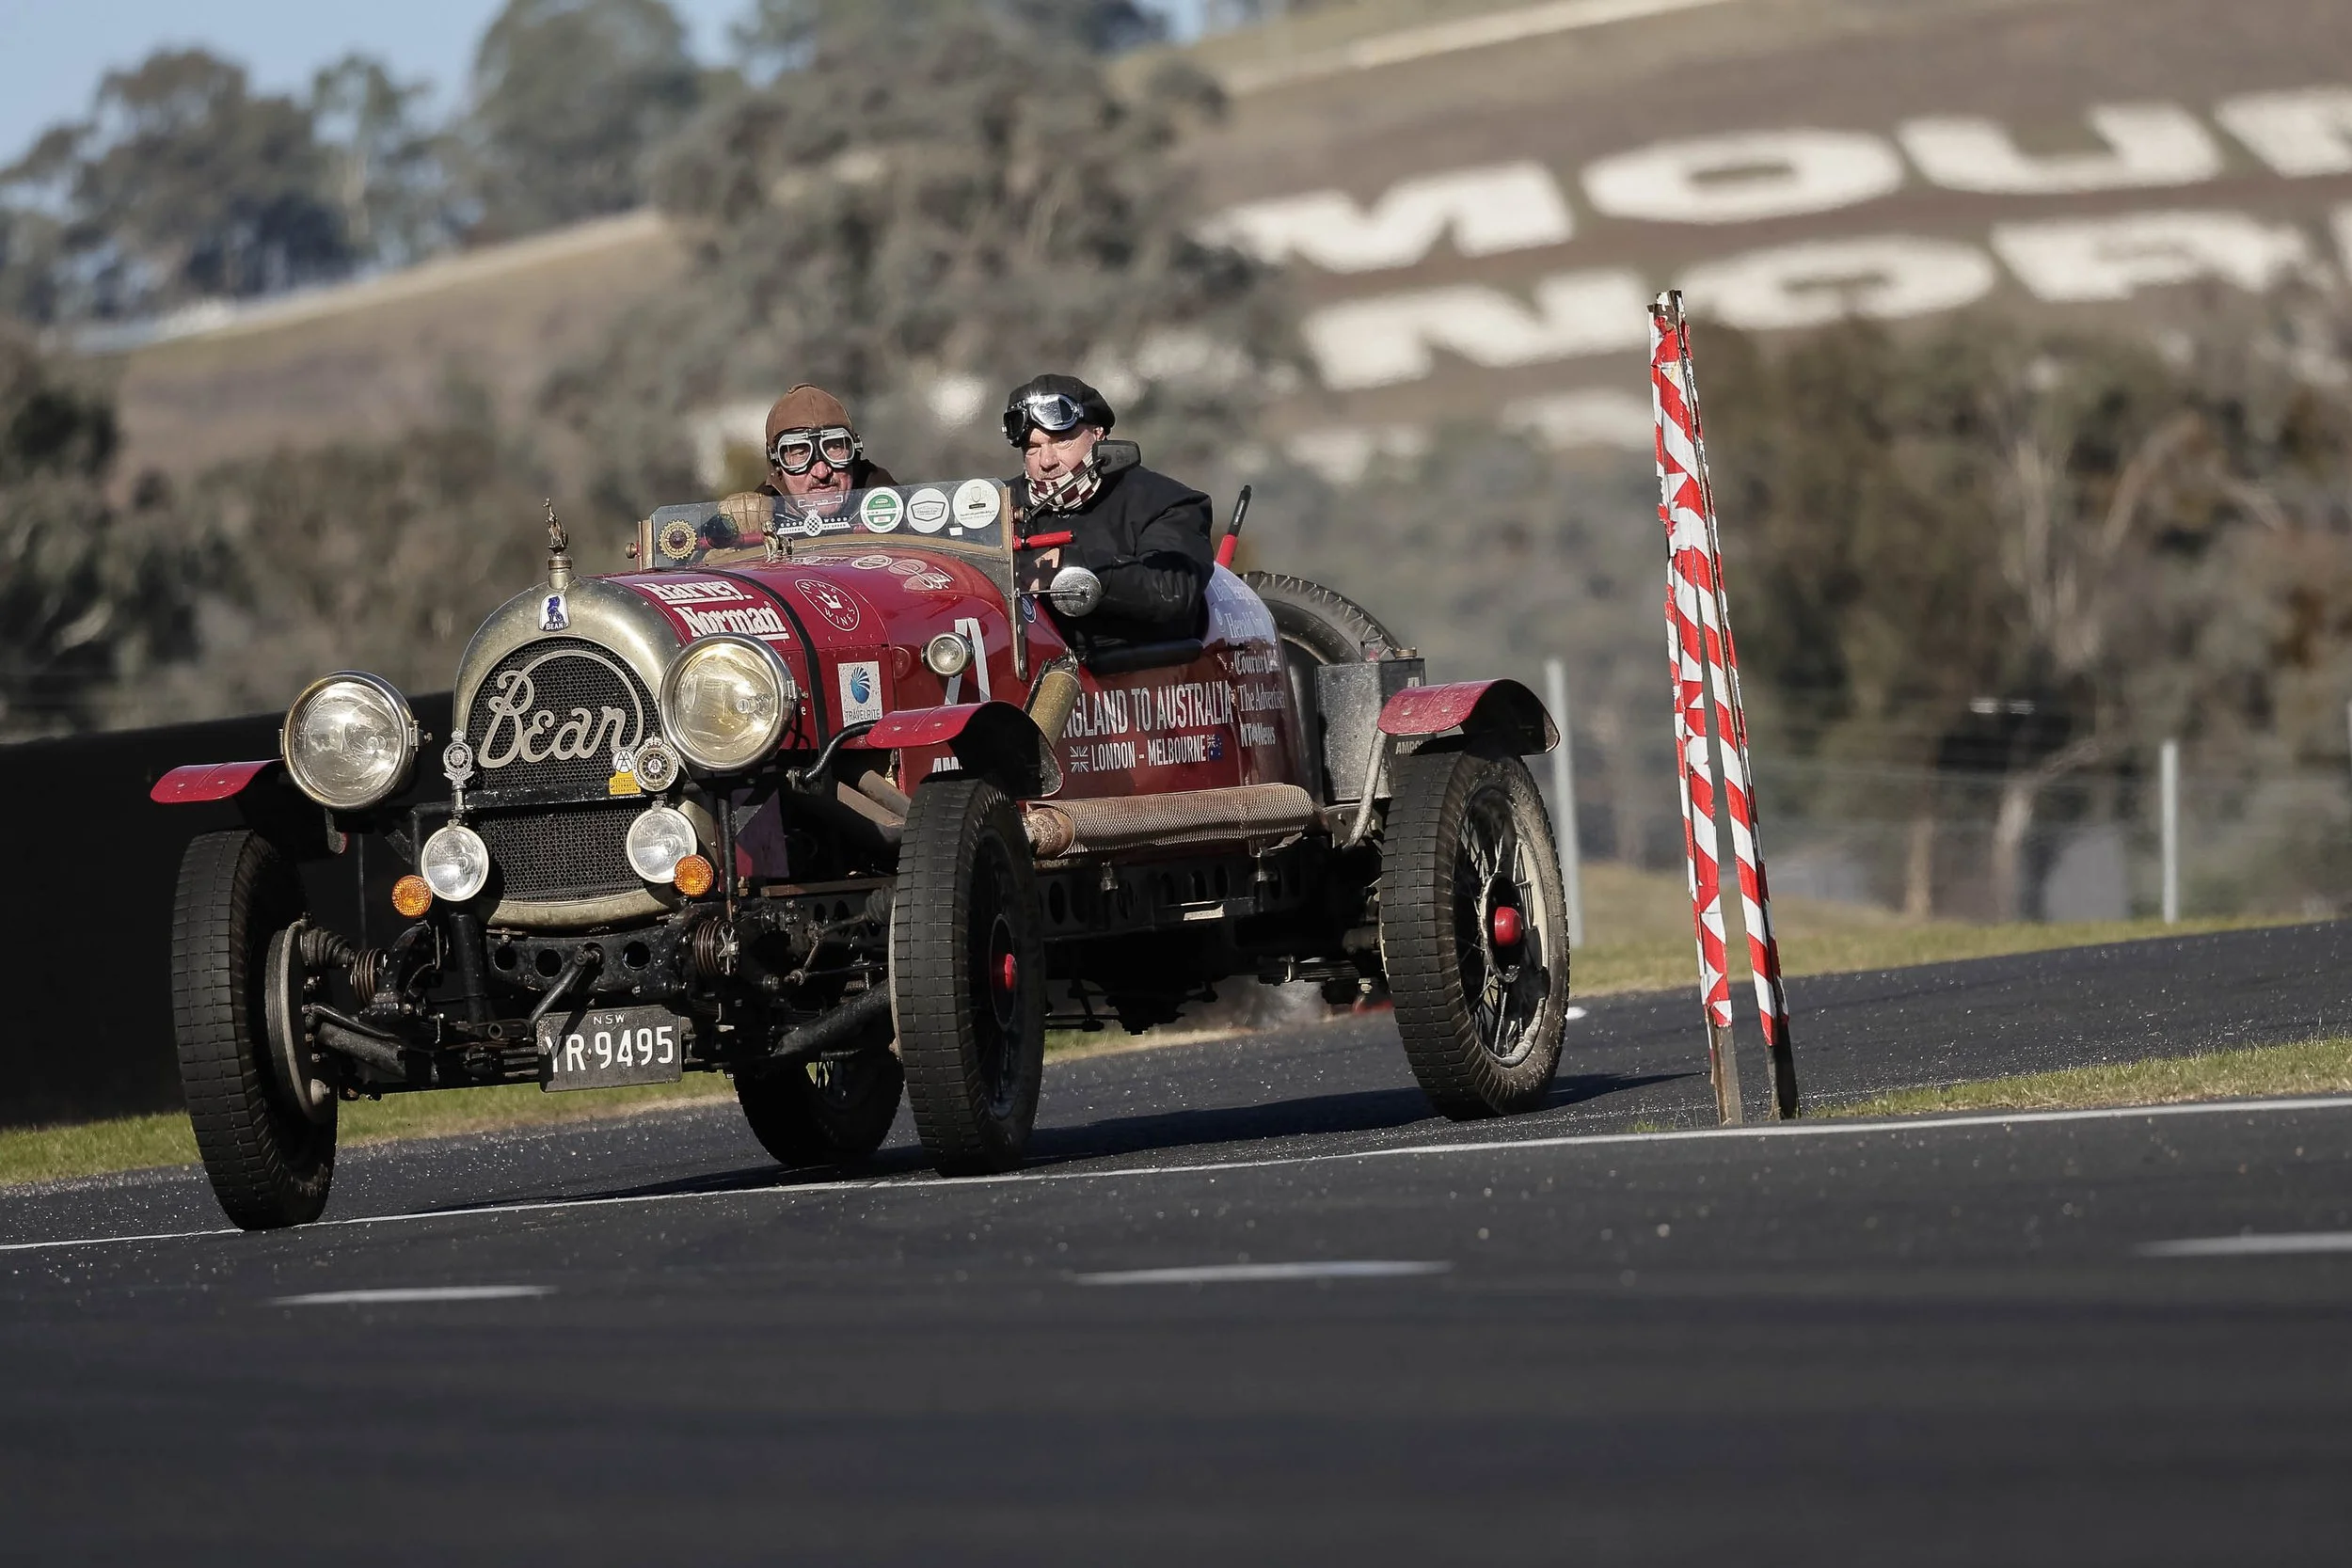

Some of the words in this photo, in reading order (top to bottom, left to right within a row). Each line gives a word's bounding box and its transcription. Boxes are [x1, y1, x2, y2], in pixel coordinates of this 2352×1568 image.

[633, 580, 744, 601] Harvey
[546, 622, 564, 630] BEAN
[673, 606, 787, 638] Norman
[824, 607, 855, 626] WINES
[478, 649, 644, 768] Bean
[845, 708, 881, 721] TRAVELRITE
[1062, 689, 1129, 738] NGLAND
[1131, 687, 1152, 733] TO
[1156, 679, 1233, 731] AUSTRALIA
[1091, 741, 1136, 772] LONDON
[1147, 734, 1207, 767] MELBOURNE
[1395, 740, 1423, 754] AMPO
[593, 1013, 626, 1025] NSW
